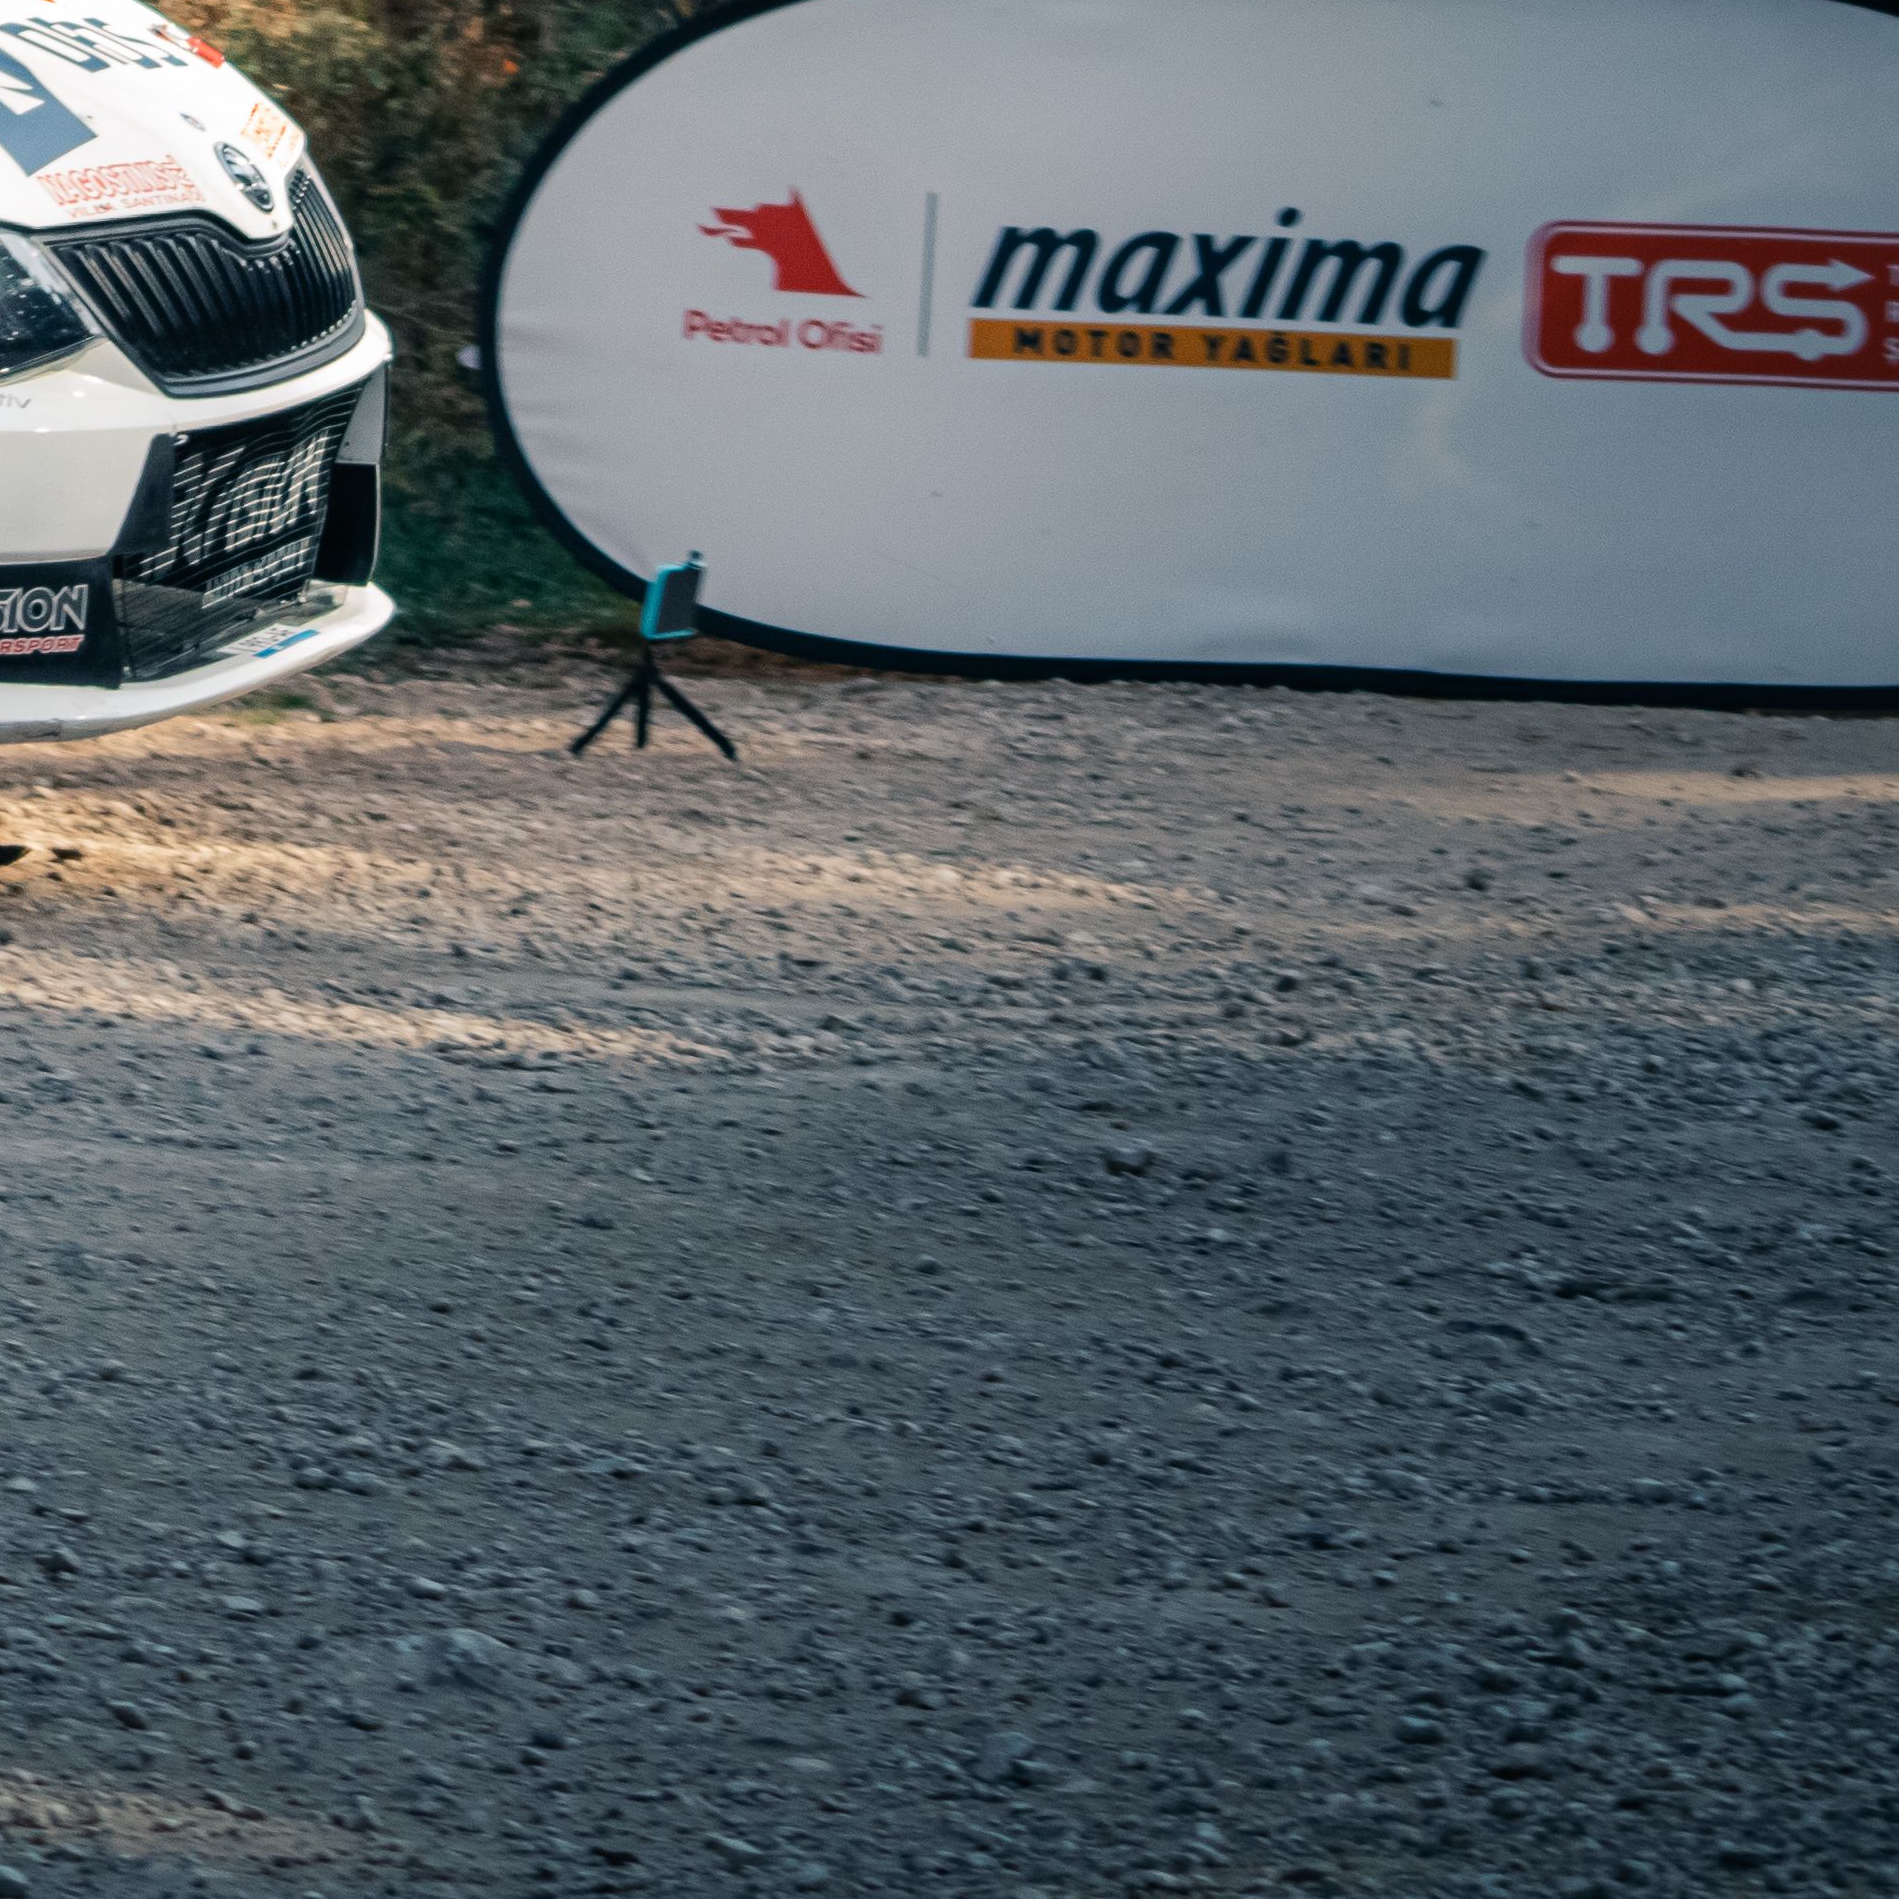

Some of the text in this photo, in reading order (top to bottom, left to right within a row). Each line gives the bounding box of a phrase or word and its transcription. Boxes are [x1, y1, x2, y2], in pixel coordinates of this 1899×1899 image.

[969, 206, 1488, 330] maxima
[682, 307, 886, 356] Petrol Ofisi
[1550, 255, 1876, 361] TRS
[1011, 325, 1413, 372] MOTOR YAĞLARI
